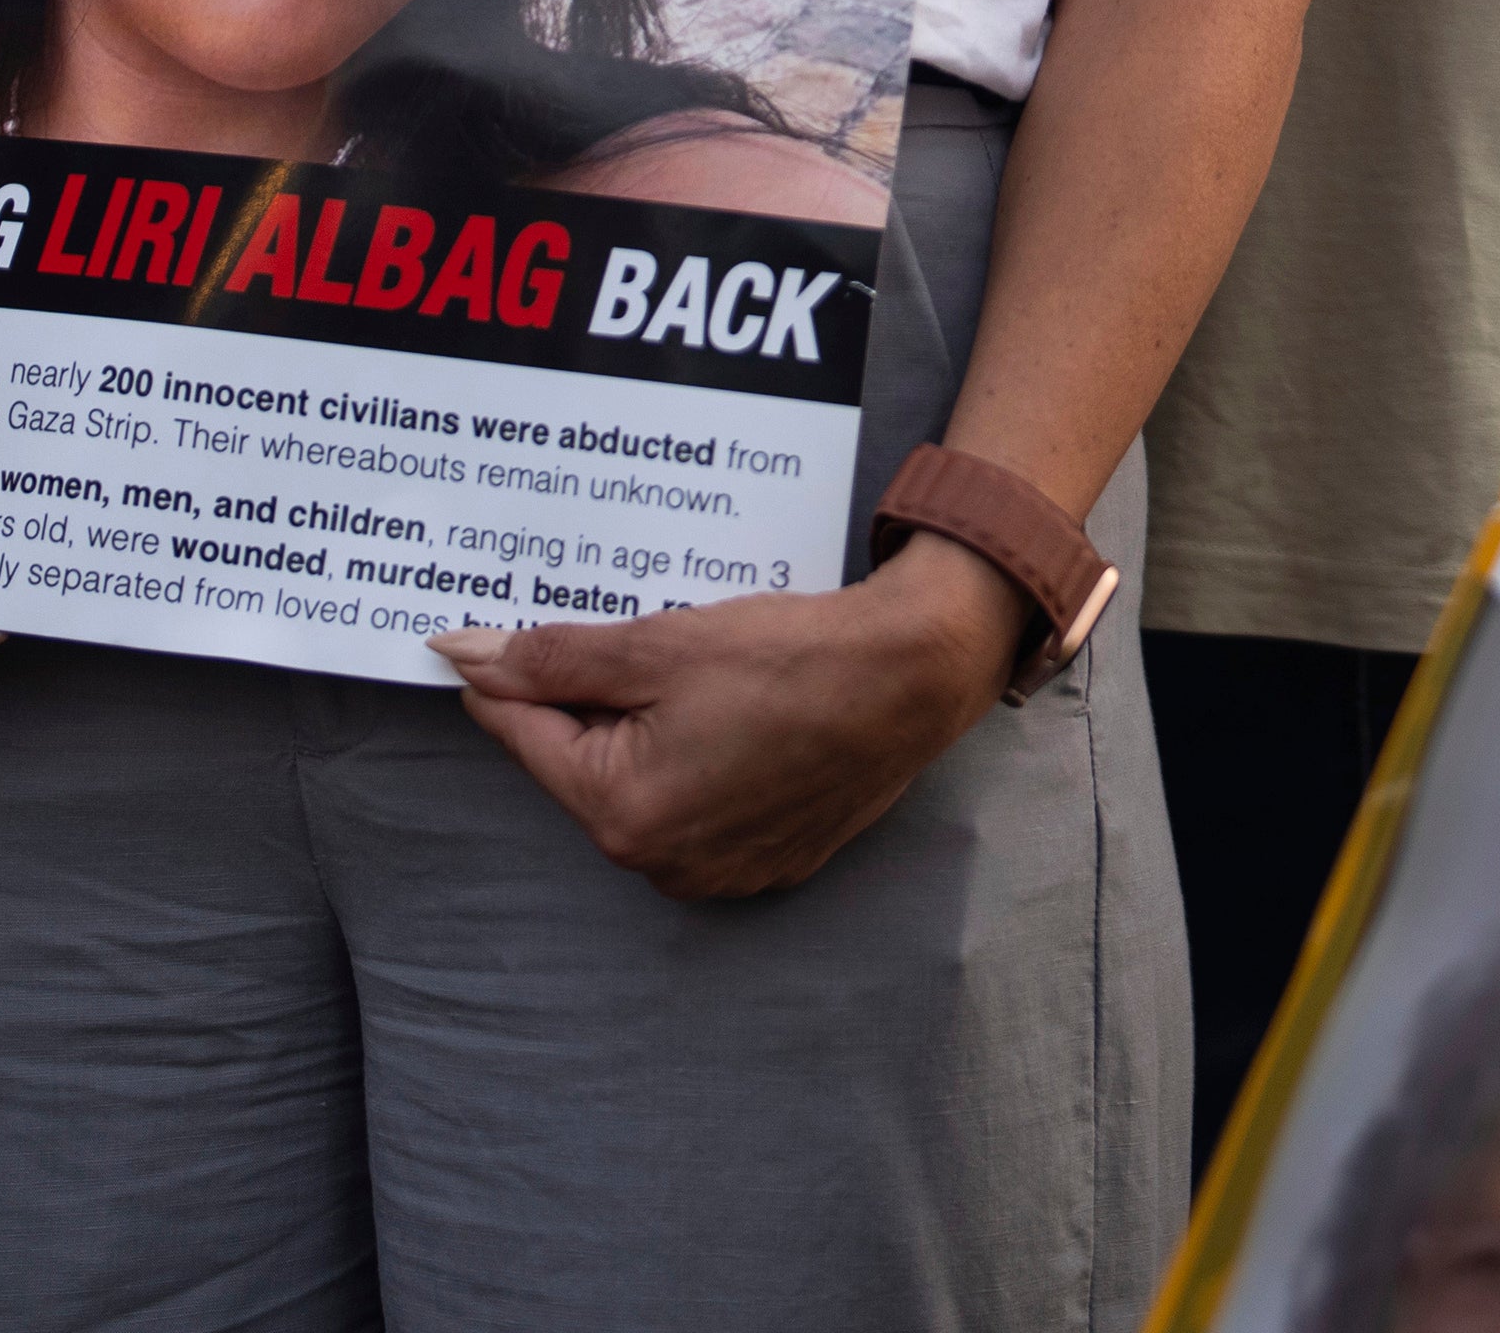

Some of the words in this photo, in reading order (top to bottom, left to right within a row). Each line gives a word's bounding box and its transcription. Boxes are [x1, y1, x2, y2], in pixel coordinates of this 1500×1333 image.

[36, 174, 222, 288] LIRI
[226, 181, 569, 329] ALBAG
[588, 247, 840, 363] BACK
[8, 401, 74, 434] Gaza
[84, 408, 159, 451] Strip.
[173, 418, 249, 455] Their
[261, 435, 465, 483] whereabouts
[477, 458, 579, 497] remain
[590, 472, 741, 517] unknown.
[10, 363, 91, 398] nearly
[99, 366, 152, 397] 200
[163, 372, 308, 418] innocent
[320, 392, 459, 434] civilians
[472, 416, 548, 444] were
[559, 422, 715, 466] abducted
[727, 442, 801, 477] from
[0, 470, 110, 507] women,
[122, 481, 201, 518] men,
[213, 493, 276, 524] and
[288, 500, 434, 546] children,
[446, 523, 564, 565] ranging
[576, 535, 600, 564] in
[611, 546, 670, 578] age
[683, 547, 757, 585] from
[770, 561, 790, 589] 3
[23, 513, 73, 546] old,
[88, 527, 160, 554] were
[172, 532, 334, 581] wounded,
[347, 555, 519, 603] murdered,
[28, 559, 182, 603] separated
[195, 579, 263, 614] from
[275, 588, 360, 625] loved
[370, 603, 449, 635] ones
